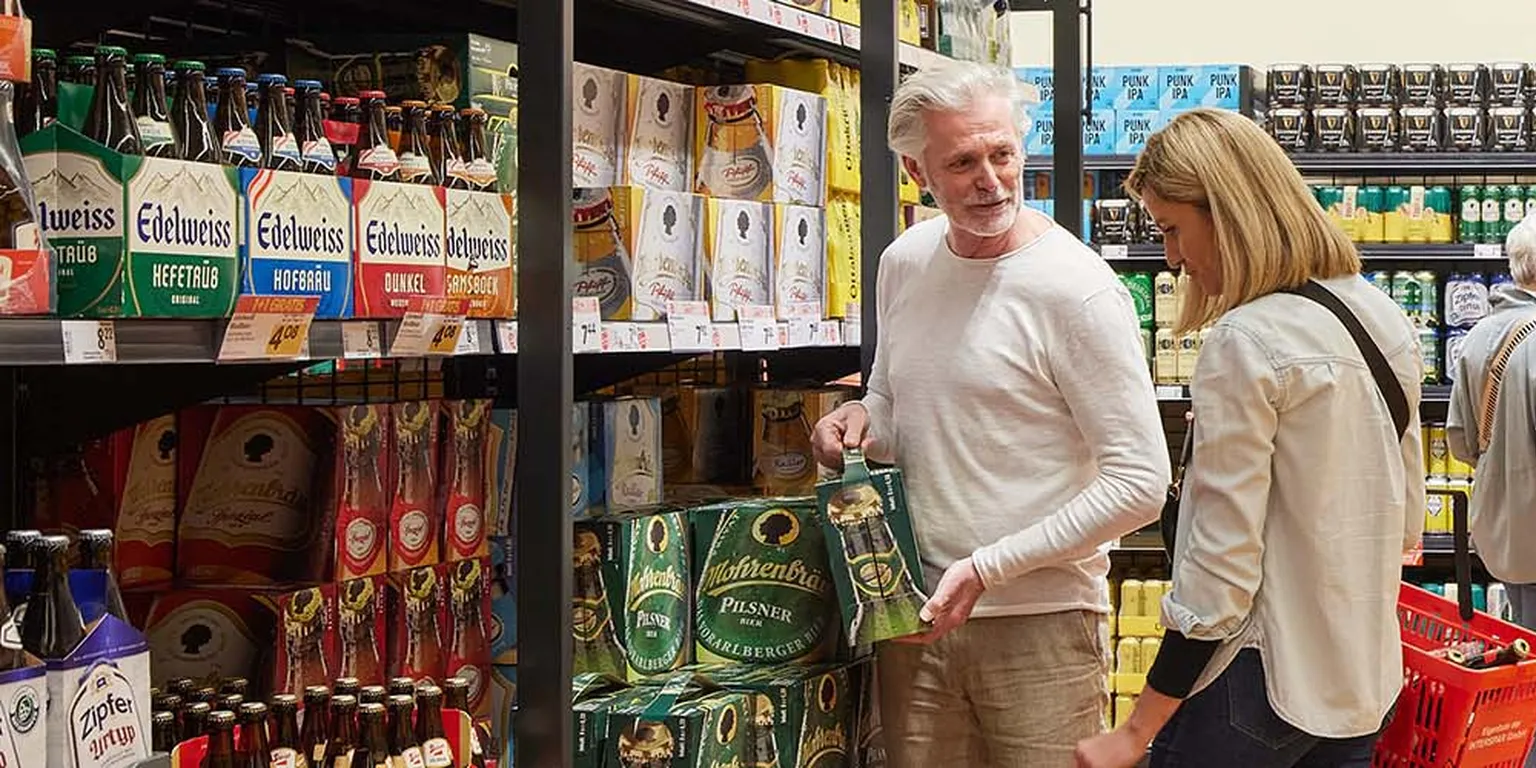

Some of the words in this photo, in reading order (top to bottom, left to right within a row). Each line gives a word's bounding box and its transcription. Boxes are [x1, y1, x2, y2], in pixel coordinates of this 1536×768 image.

[1035, 76, 1053, 88] PUN
[1123, 76, 1149, 87] PUNK
[1167, 75, 1194, 87] PUNK
[1211, 73, 1237, 85] PUNK
[1128, 89, 1143, 100] IPA
[1172, 88, 1188, 99] IPA
[1216, 87, 1231, 98] IPA
[1036, 120, 1053, 132] PUN
[1124, 120, 1150, 131] PUNK
[1130, 133, 1145, 144] IPA
[39, 200, 115, 231] lweiss
[136, 202, 231, 249] Edelweiss
[257, 212, 344, 254] Edelweiss
[366, 220, 440, 259] Edelweiss
[57, 241, 97, 264] TRÜB
[447, 227, 508, 262] delweiss
[152, 260, 219, 289] HEFETRÜB
[273, 264, 331, 292] HOFBRÄU
[384, 272, 426, 294] DUNKEL
[720, 596, 793, 623] PILSNER
[79, 692, 134, 741] Zipfer
